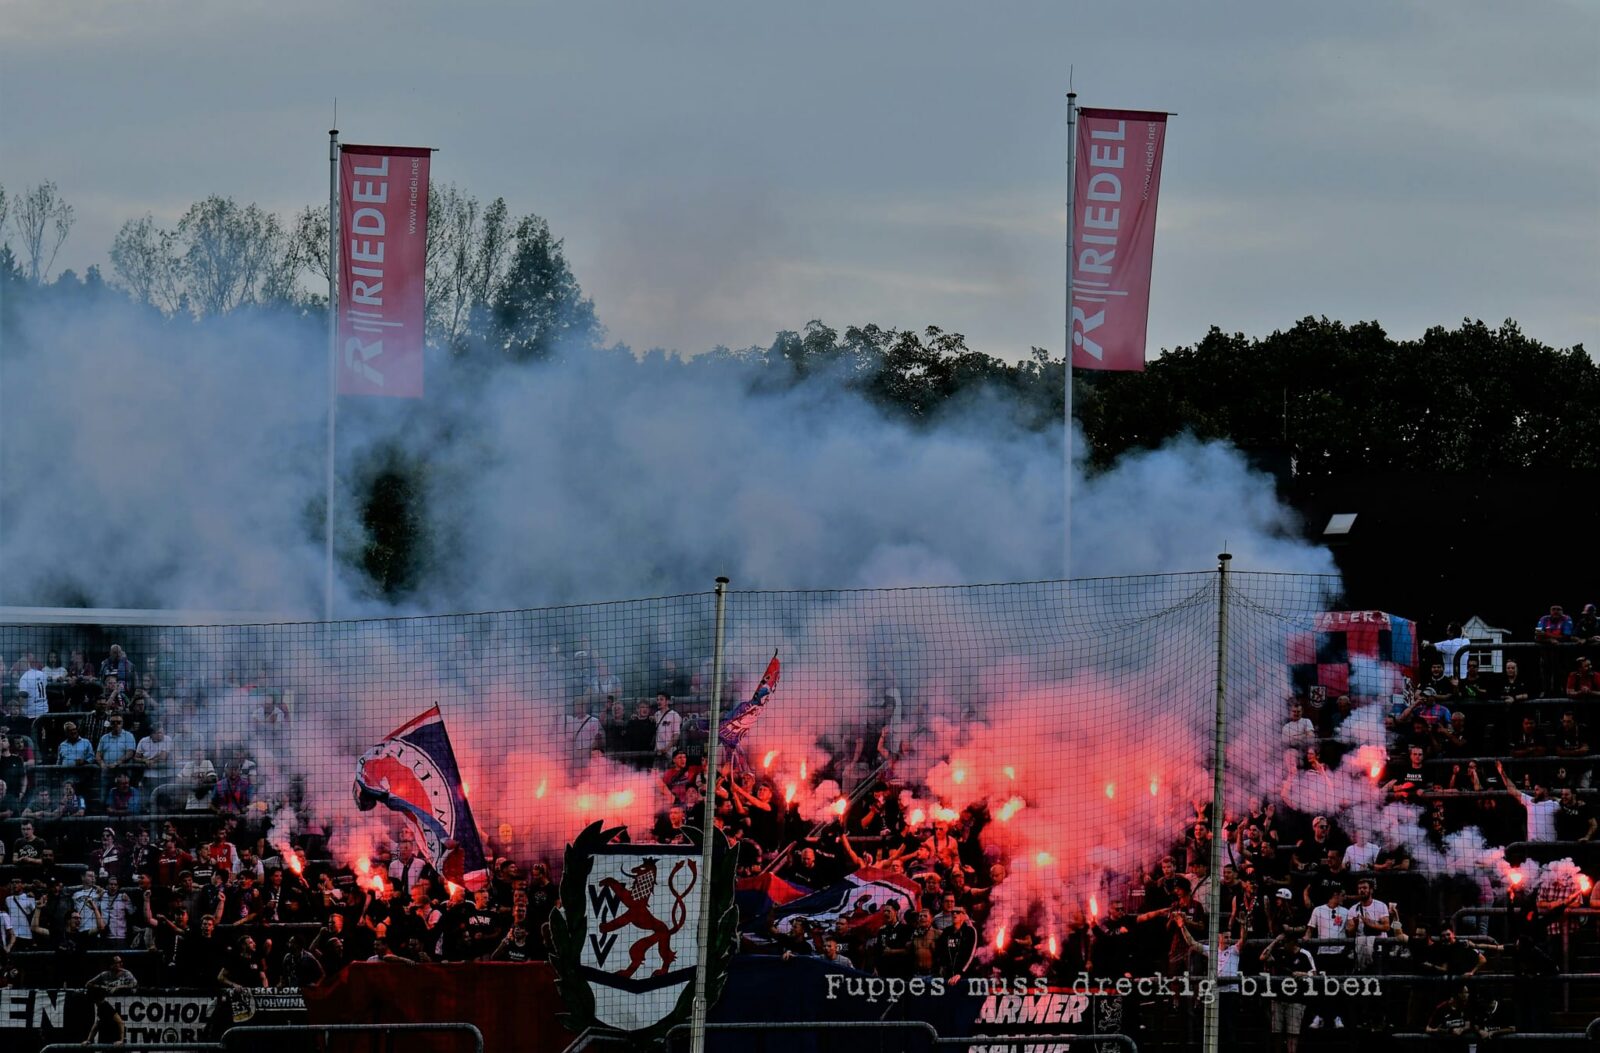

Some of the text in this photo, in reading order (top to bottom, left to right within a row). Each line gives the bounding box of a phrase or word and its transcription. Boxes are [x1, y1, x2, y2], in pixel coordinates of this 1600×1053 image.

[408, 157, 419, 235] www.riedel.net
[1079, 120, 1126, 274] RIEDEL
[1142, 122, 1157, 201] www.riedel.net
[351, 156, 389, 306] RIEDEL
[0, 989, 66, 1028] EN
[113, 1001, 211, 1023] LCOHOL
[974, 993, 1090, 1025] ARMER
